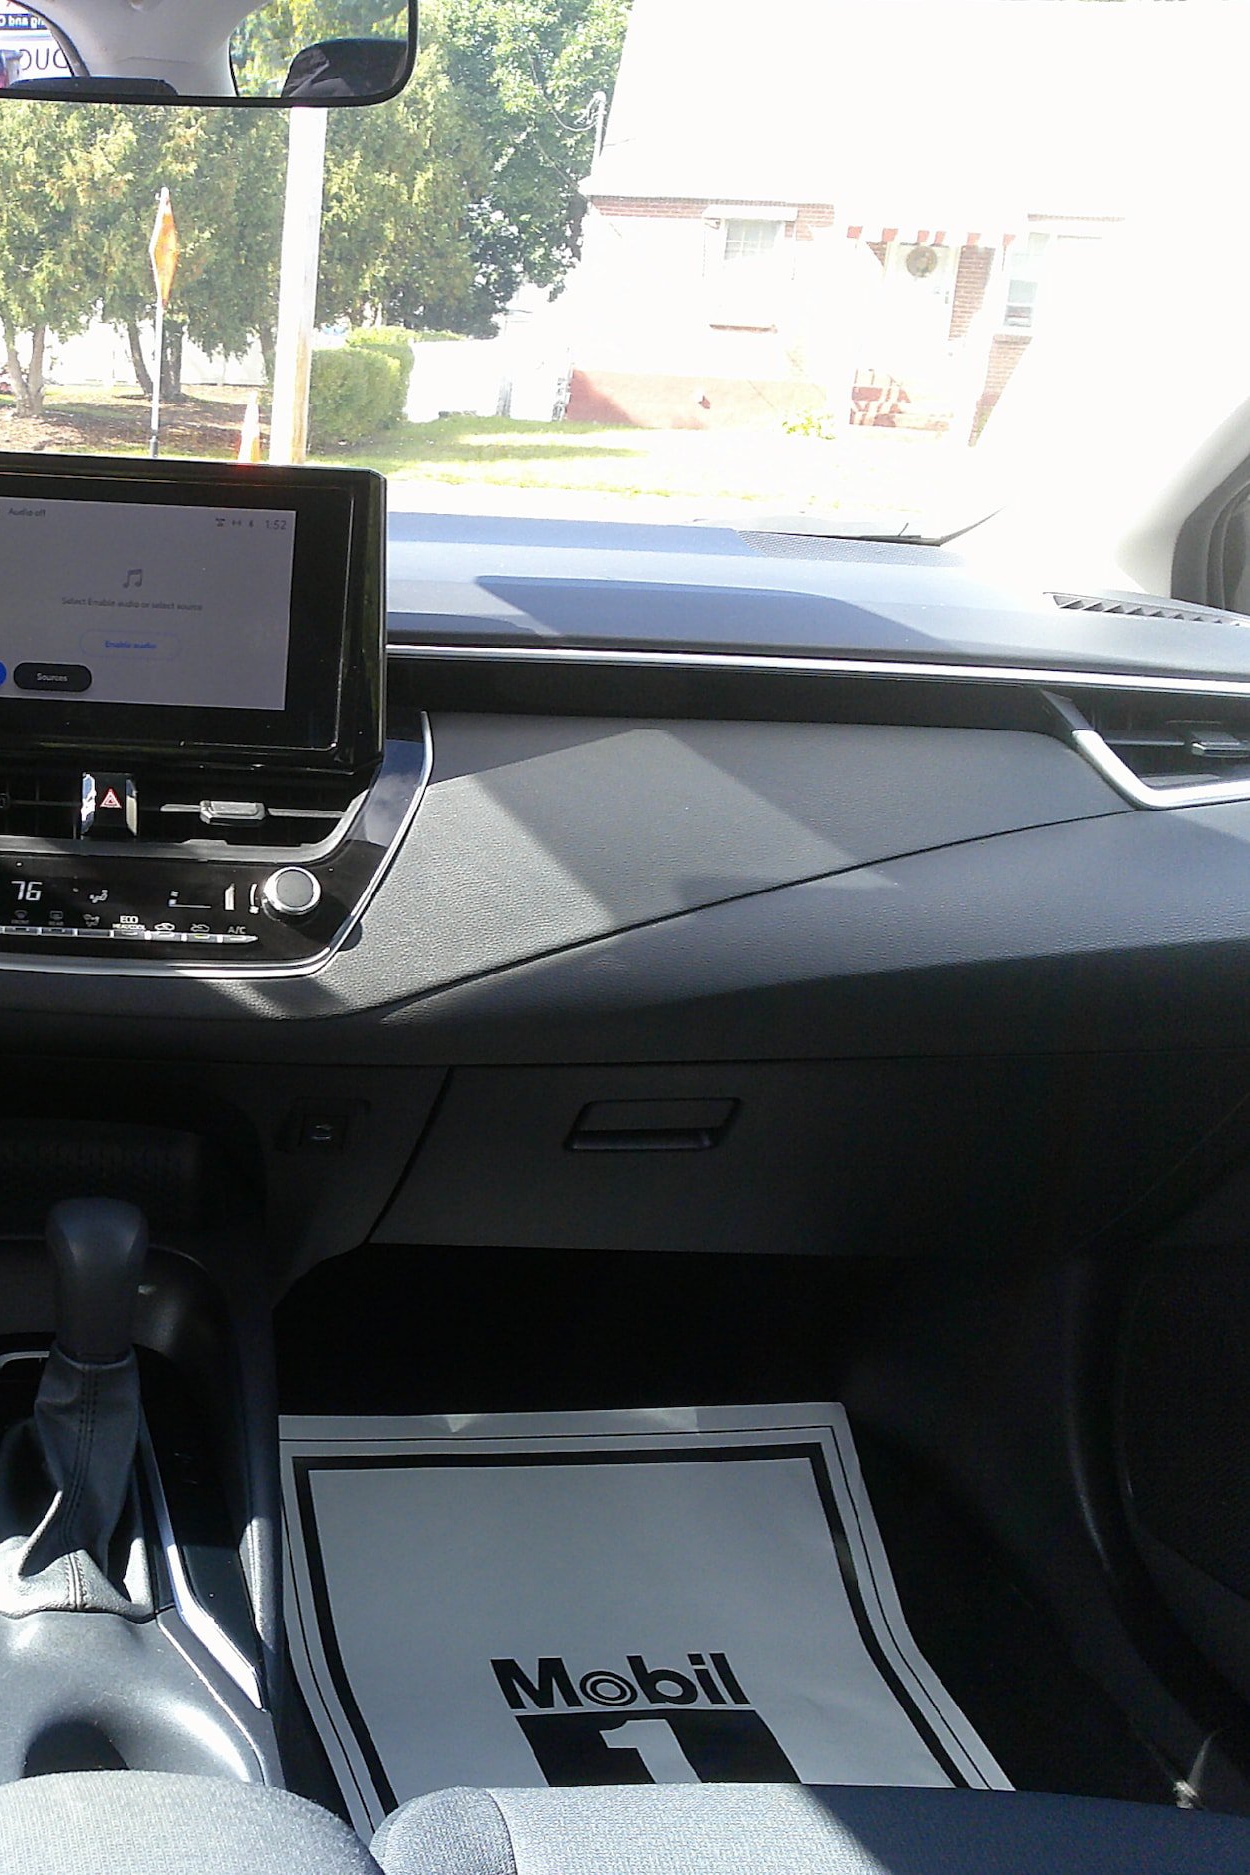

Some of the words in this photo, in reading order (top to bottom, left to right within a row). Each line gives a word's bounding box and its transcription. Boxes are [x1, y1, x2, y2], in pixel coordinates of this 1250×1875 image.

[8, 507, 33, 517] Audio
[34, 508, 46, 518] off
[264, 519, 287, 530] 1:52
[36, 672, 68, 682] Sources
[11, 880, 43, 901] 76
[120, 915, 139, 924] ECO
[227, 925, 247, 935] A/C
[490, 1652, 751, 1710] Mobil
